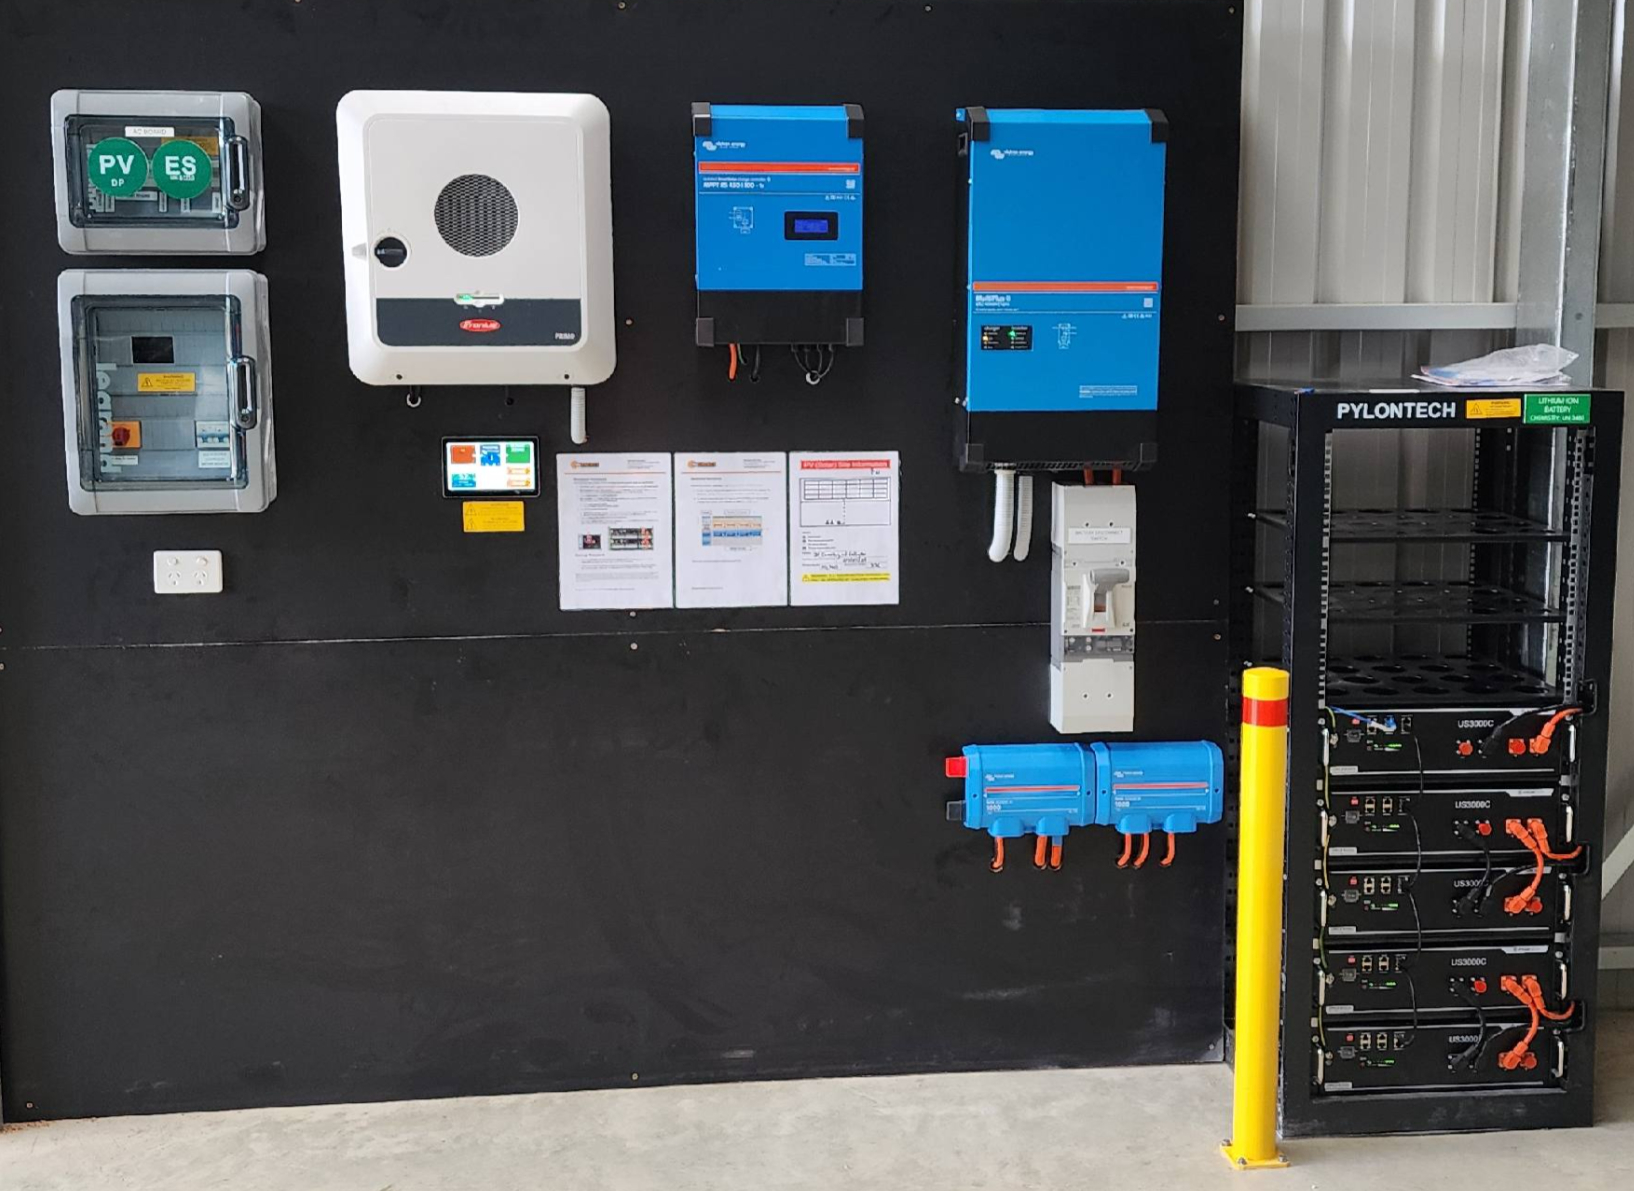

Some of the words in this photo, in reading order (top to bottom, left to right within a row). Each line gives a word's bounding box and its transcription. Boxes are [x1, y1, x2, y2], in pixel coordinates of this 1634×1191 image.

[99, 155, 134, 175] PV
[165, 155, 197, 175] ES
[1337, 402, 1456, 419] PYLONTECH
[1543, 405, 1571, 413] BATTERY
[1458, 720, 1494, 728] US3000C
[1455, 801, 1490, 809] US3000C
[1451, 958, 1487, 966] US3000C
